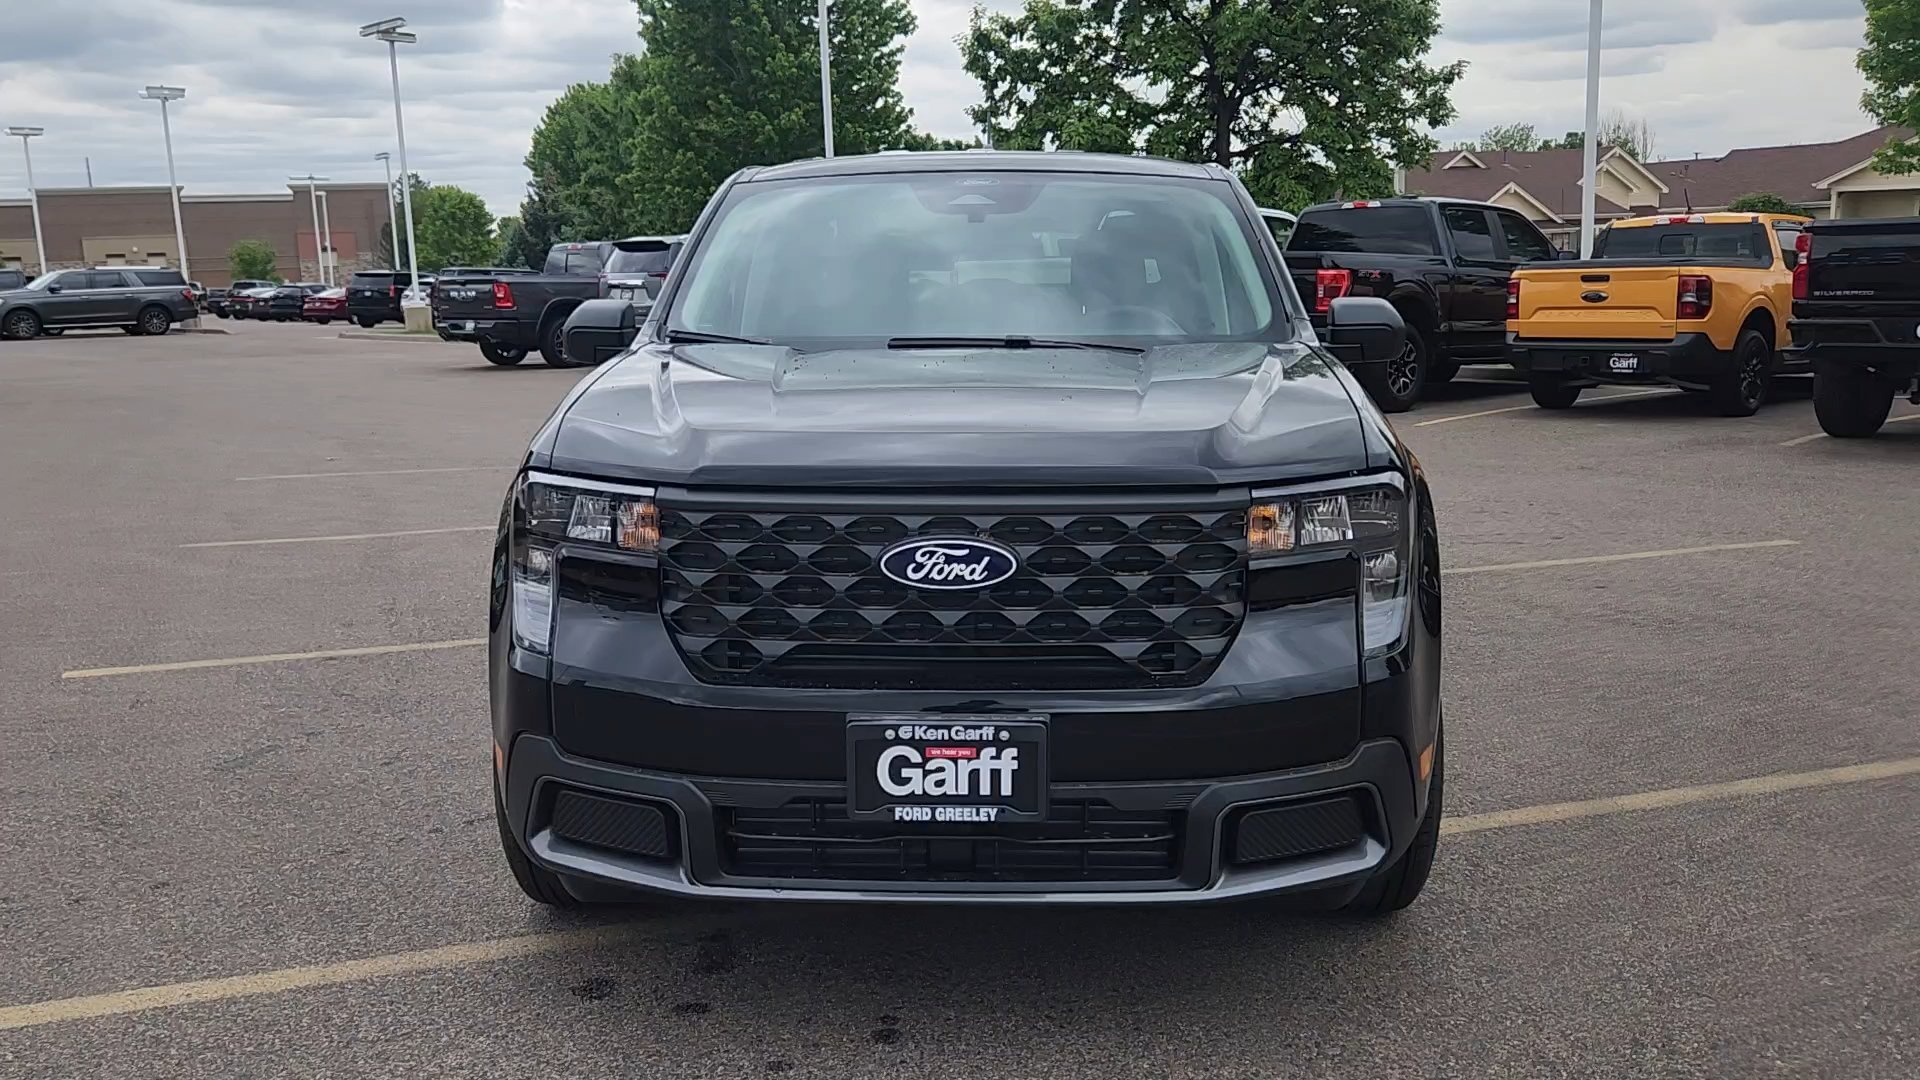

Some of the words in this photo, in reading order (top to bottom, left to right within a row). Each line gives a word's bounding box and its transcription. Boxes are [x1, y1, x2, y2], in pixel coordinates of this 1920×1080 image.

[450, 290, 477, 298] RAM
[1610, 357, 1638, 369] Garff
[906, 546, 991, 581] Ford
[914, 725, 949, 740] Ken
[950, 725, 995, 741] Garff
[958, 749, 971, 757] you
[876, 745, 1019, 797] Garff
[894, 807, 932, 821] FORD
[935, 807, 998, 822] GREELEY
